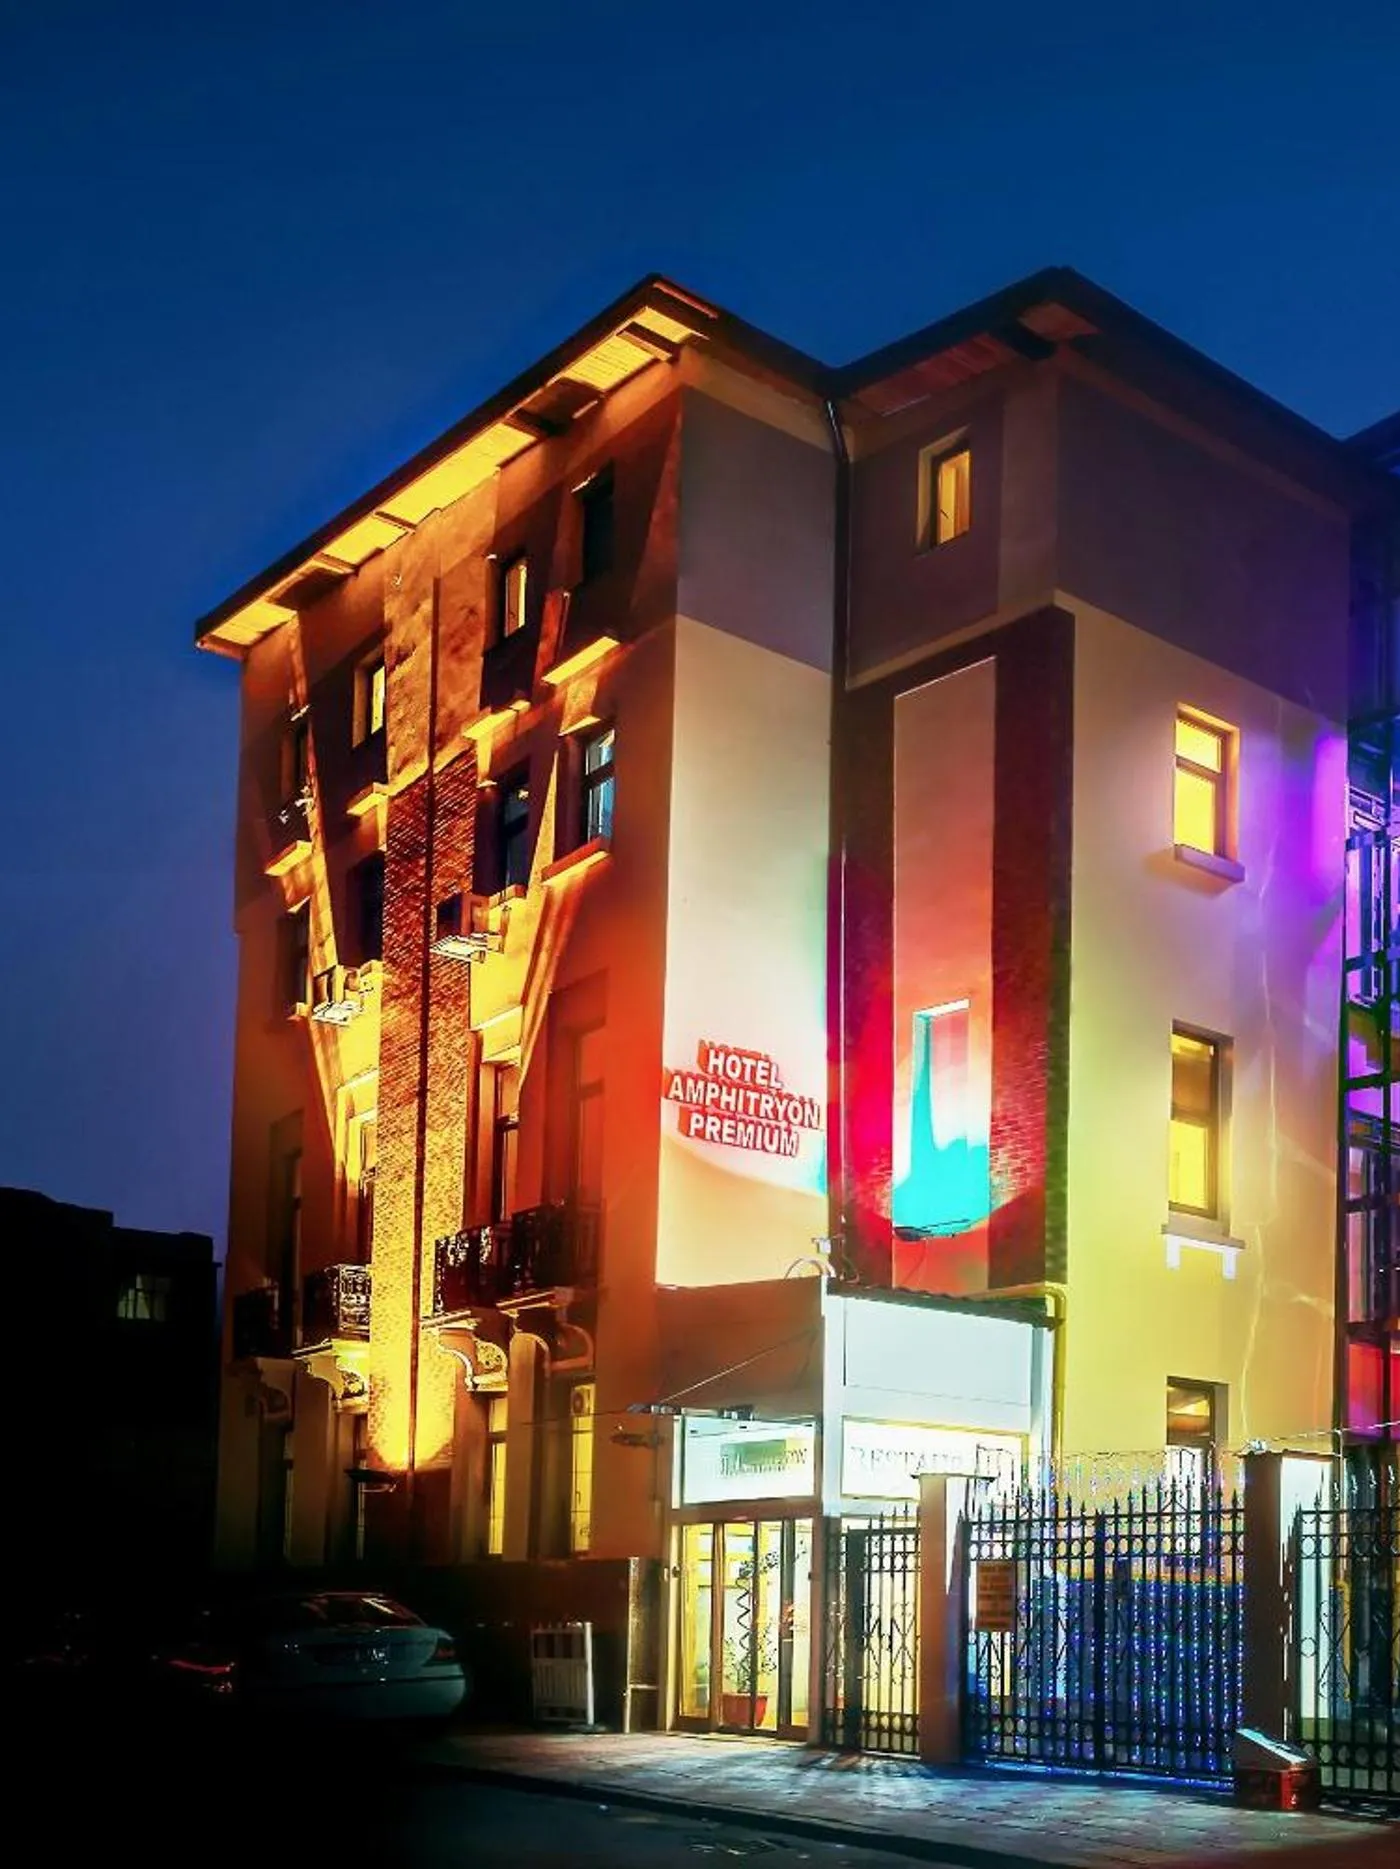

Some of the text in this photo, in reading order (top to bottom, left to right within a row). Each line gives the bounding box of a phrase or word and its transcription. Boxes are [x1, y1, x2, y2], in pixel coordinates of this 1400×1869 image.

[707, 1049, 783, 1090] HOTEL
[667, 1074, 821, 1130] AMPHITRYON
[688, 1111, 799, 1157] PREMIUM
